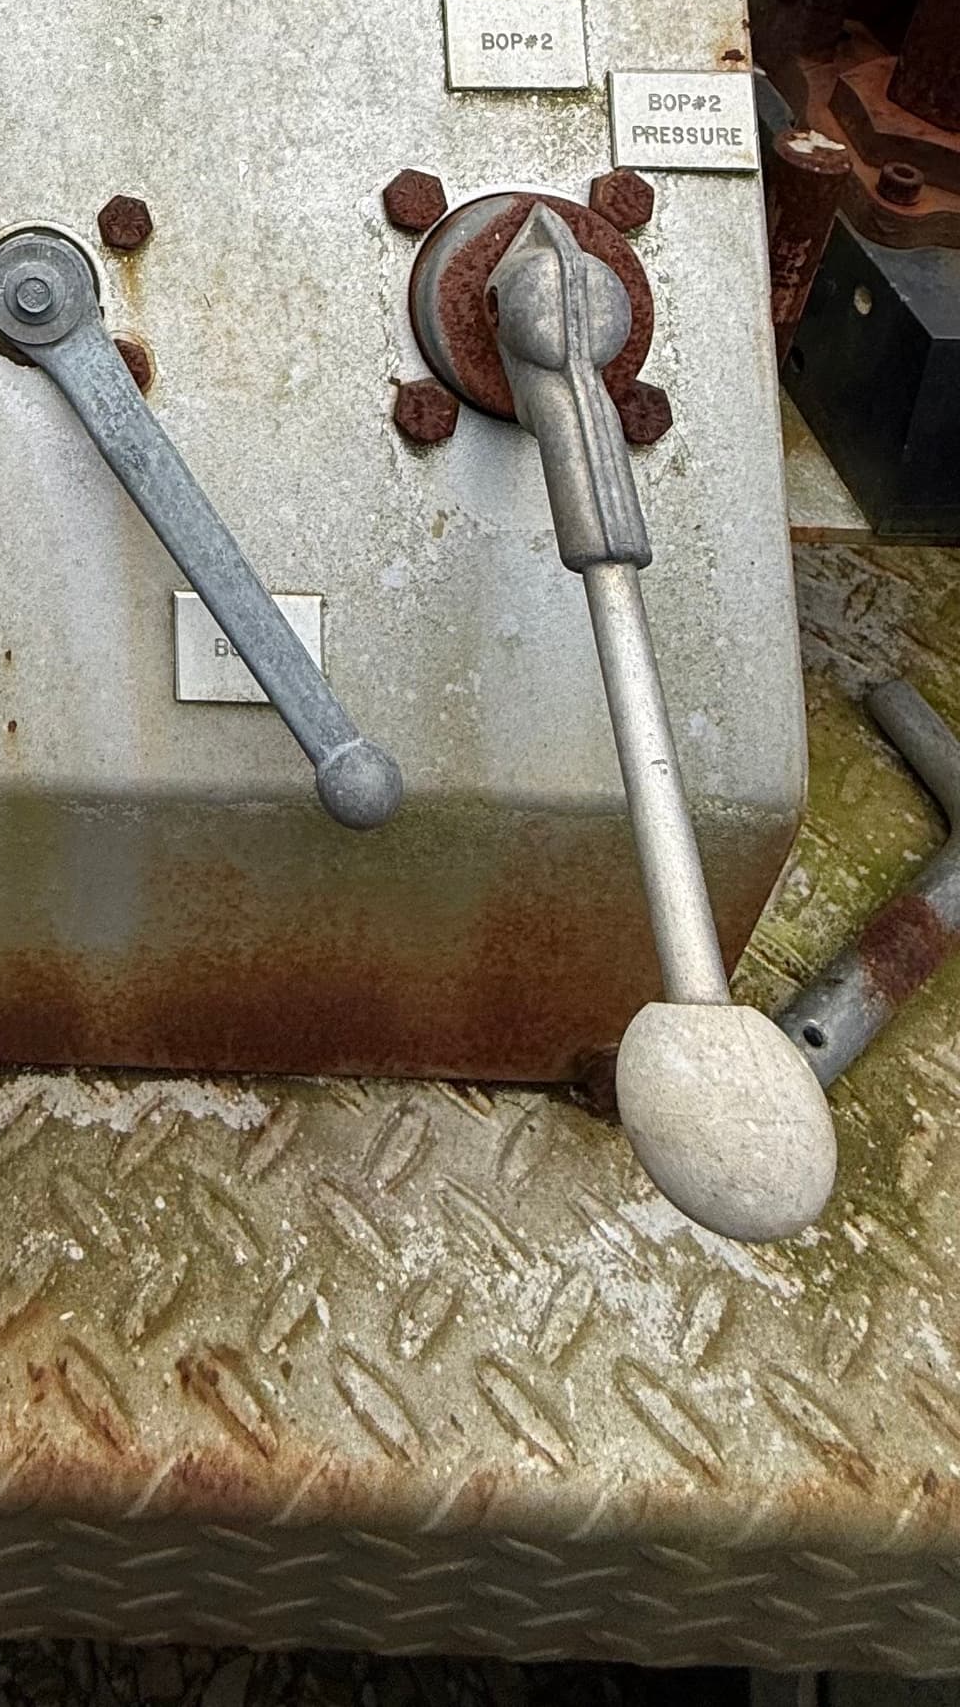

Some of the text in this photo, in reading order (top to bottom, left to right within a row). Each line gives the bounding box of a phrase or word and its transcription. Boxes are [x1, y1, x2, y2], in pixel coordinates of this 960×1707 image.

[481, 32, 553, 51] BOP#2
[648, 93, 722, 113] BOP#2
[631, 125, 743, 147] PRESSURE
